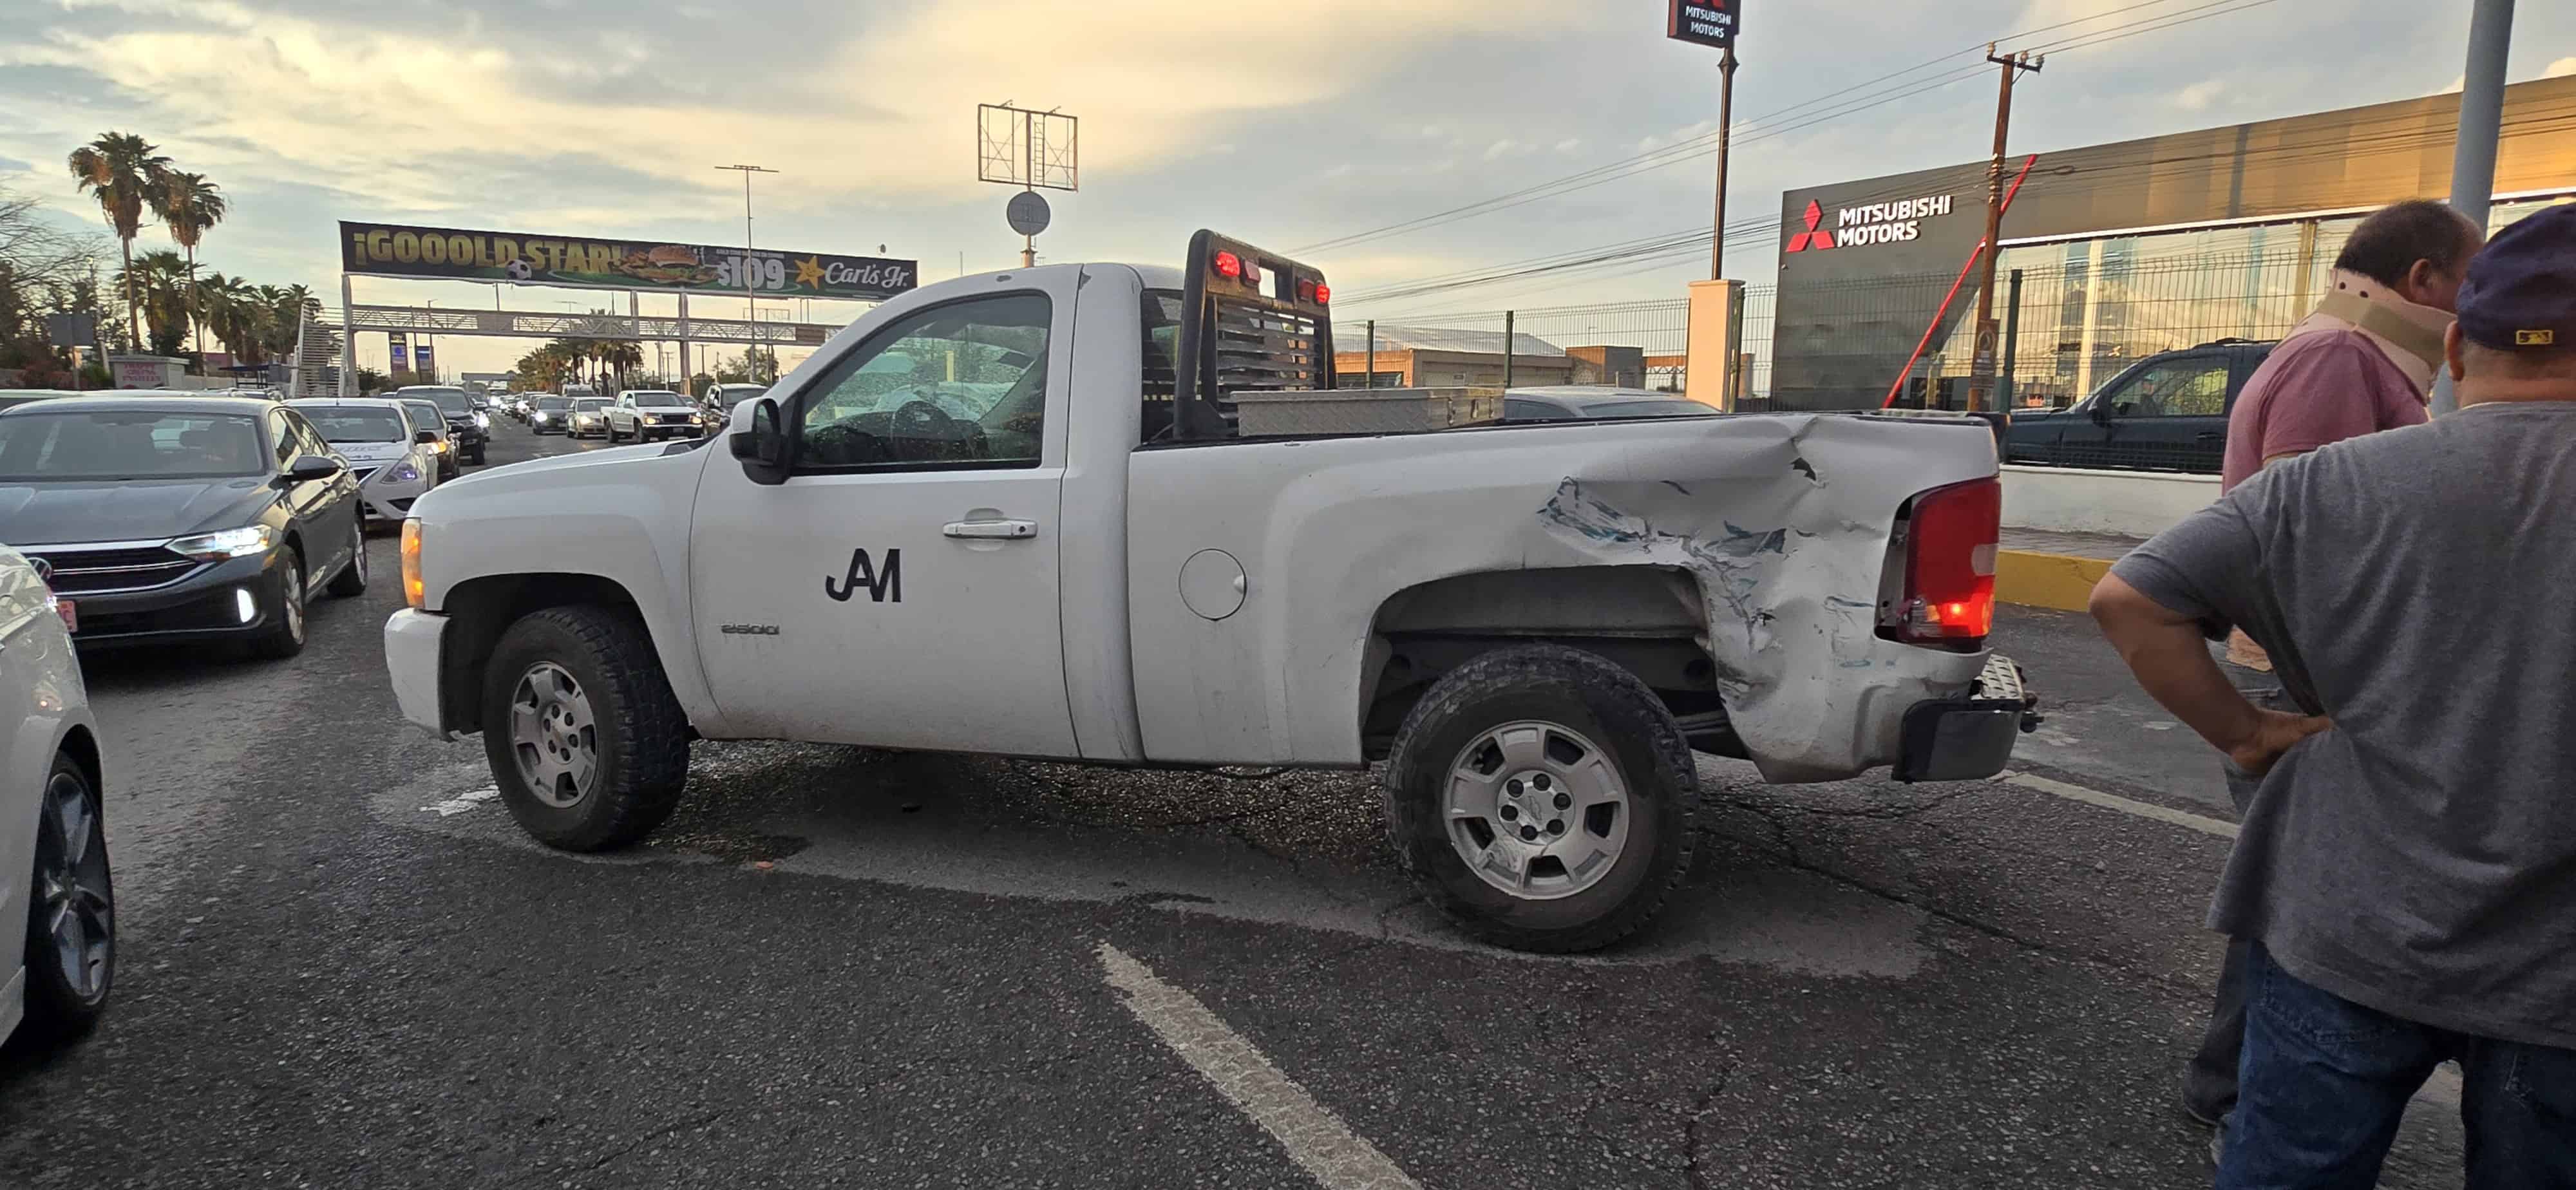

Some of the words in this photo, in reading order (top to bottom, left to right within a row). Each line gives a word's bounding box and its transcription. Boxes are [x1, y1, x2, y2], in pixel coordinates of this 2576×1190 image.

[1685, 5, 1731, 25] MITSUBISHI
[1690, 21, 1725, 38] MOTORS
[1838, 194, 1952, 227] MITSUBISHI
[1837, 220, 1918, 248] MOTORS
[525, 239, 621, 274] STAR!
[717, 256, 785, 289] $109
[824, 261, 879, 285] Carl's
[878, 265, 909, 288] Jr.
[825, 548, 902, 603] JAM
[721, 623, 780, 636] 2500
